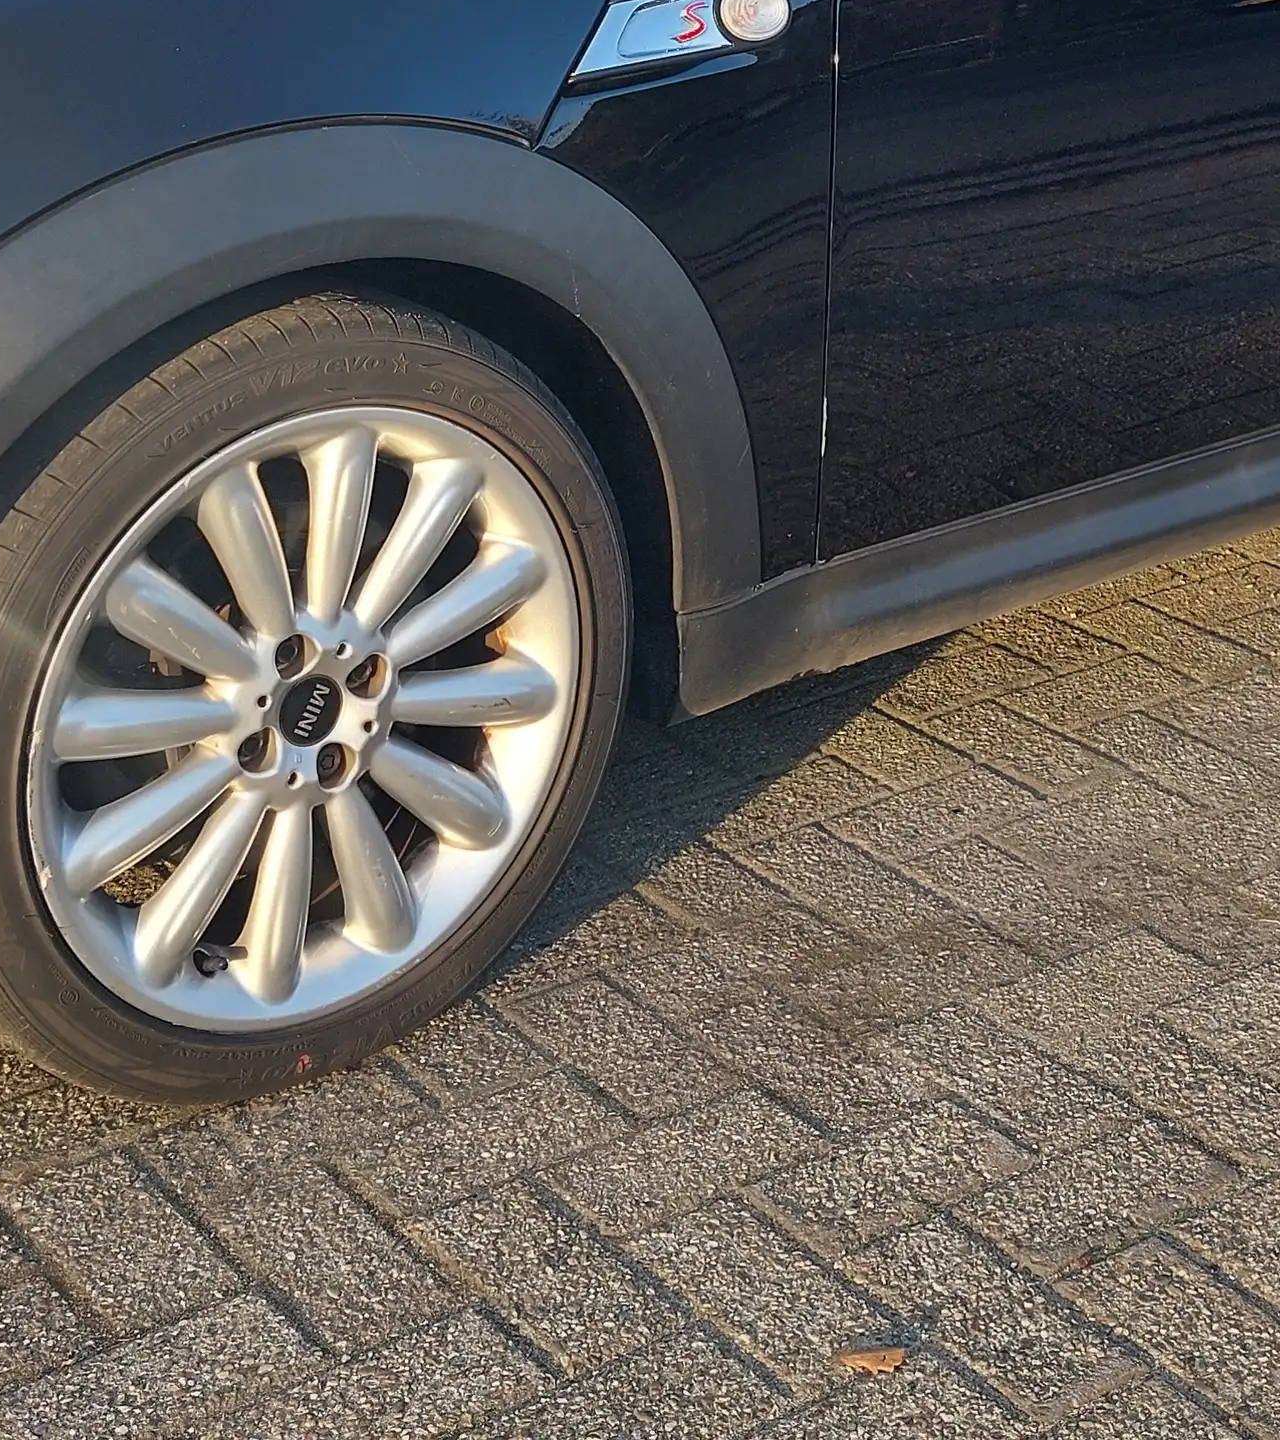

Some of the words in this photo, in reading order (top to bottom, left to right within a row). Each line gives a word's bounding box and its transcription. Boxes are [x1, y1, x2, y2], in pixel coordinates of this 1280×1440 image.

[669, 1, 709, 44] S
[155, 390, 249, 453] VENTUS
[293, 683, 331, 739] MINI
